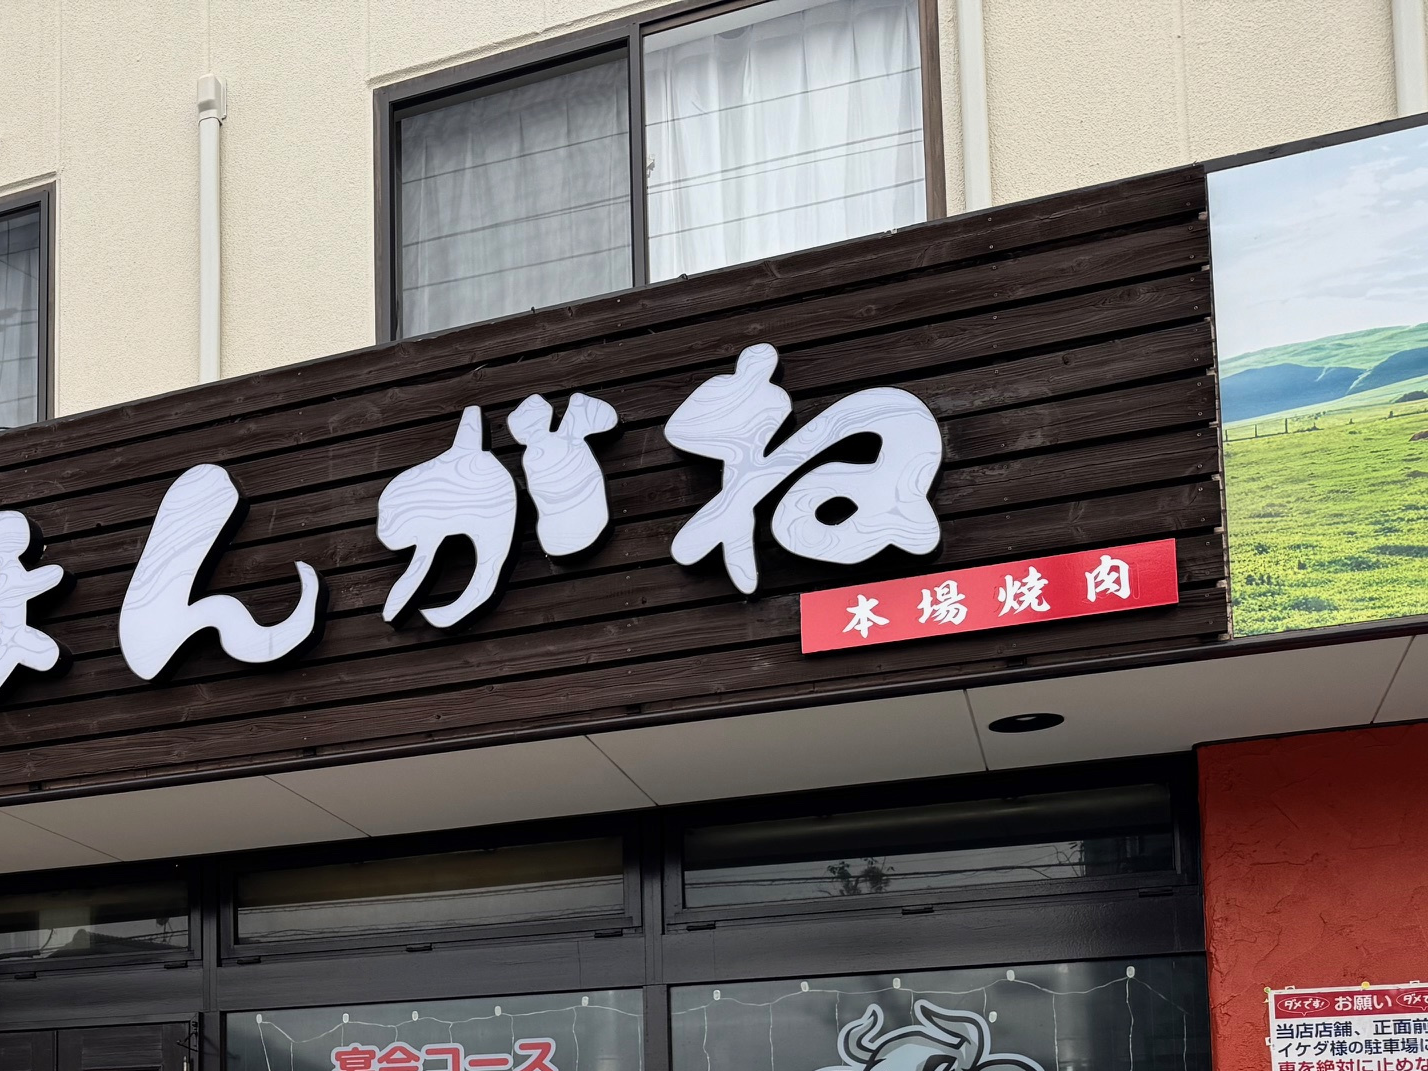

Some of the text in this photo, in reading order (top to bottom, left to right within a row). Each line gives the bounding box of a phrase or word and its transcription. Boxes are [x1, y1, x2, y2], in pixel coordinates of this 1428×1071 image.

[842, 553, 1132, 641] 本場焼肉
[1334, 994, 1393, 1012] お願い
